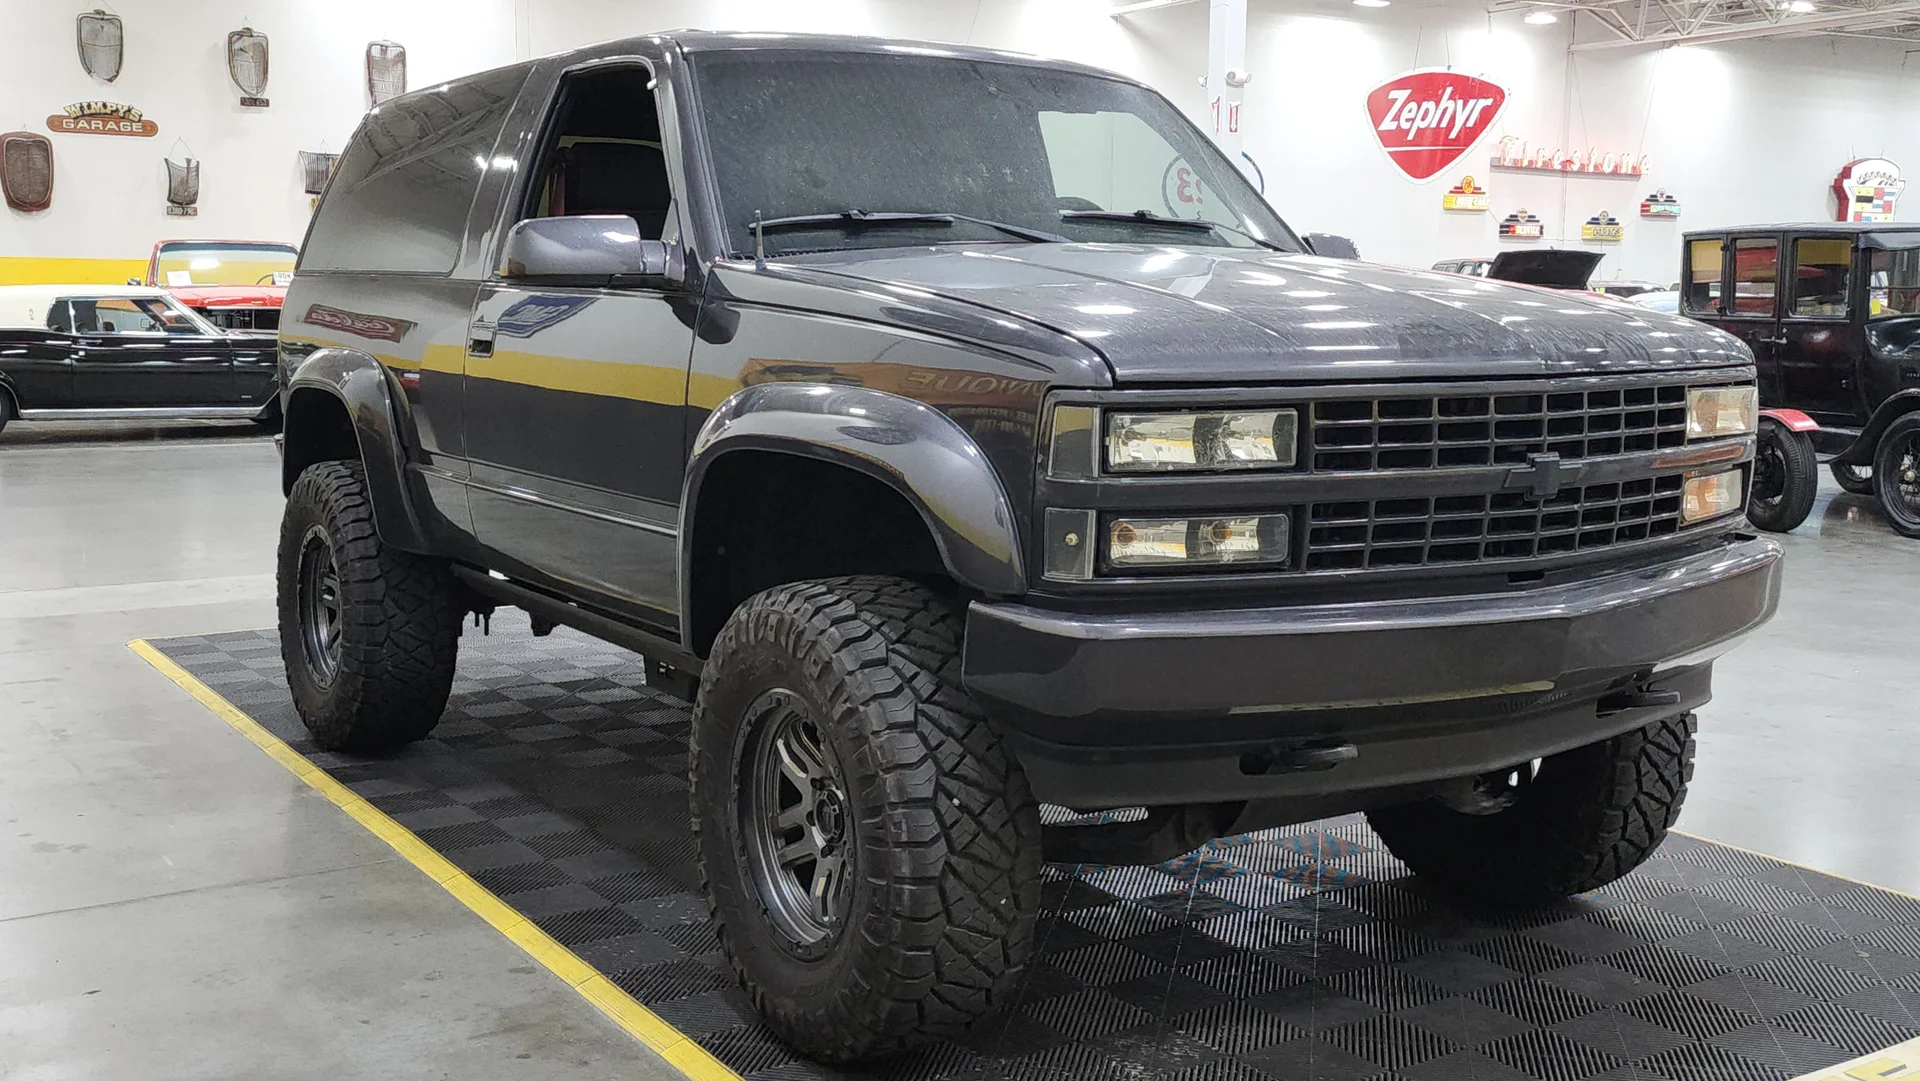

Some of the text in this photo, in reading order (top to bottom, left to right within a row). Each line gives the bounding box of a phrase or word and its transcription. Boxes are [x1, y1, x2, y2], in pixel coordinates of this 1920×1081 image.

[62, 119, 143, 132] GARAGE
[63, 101, 142, 122] WIMPY'S
[1377, 86, 1494, 141] Zephyr
[1499, 135, 1649, 175] Firestone
